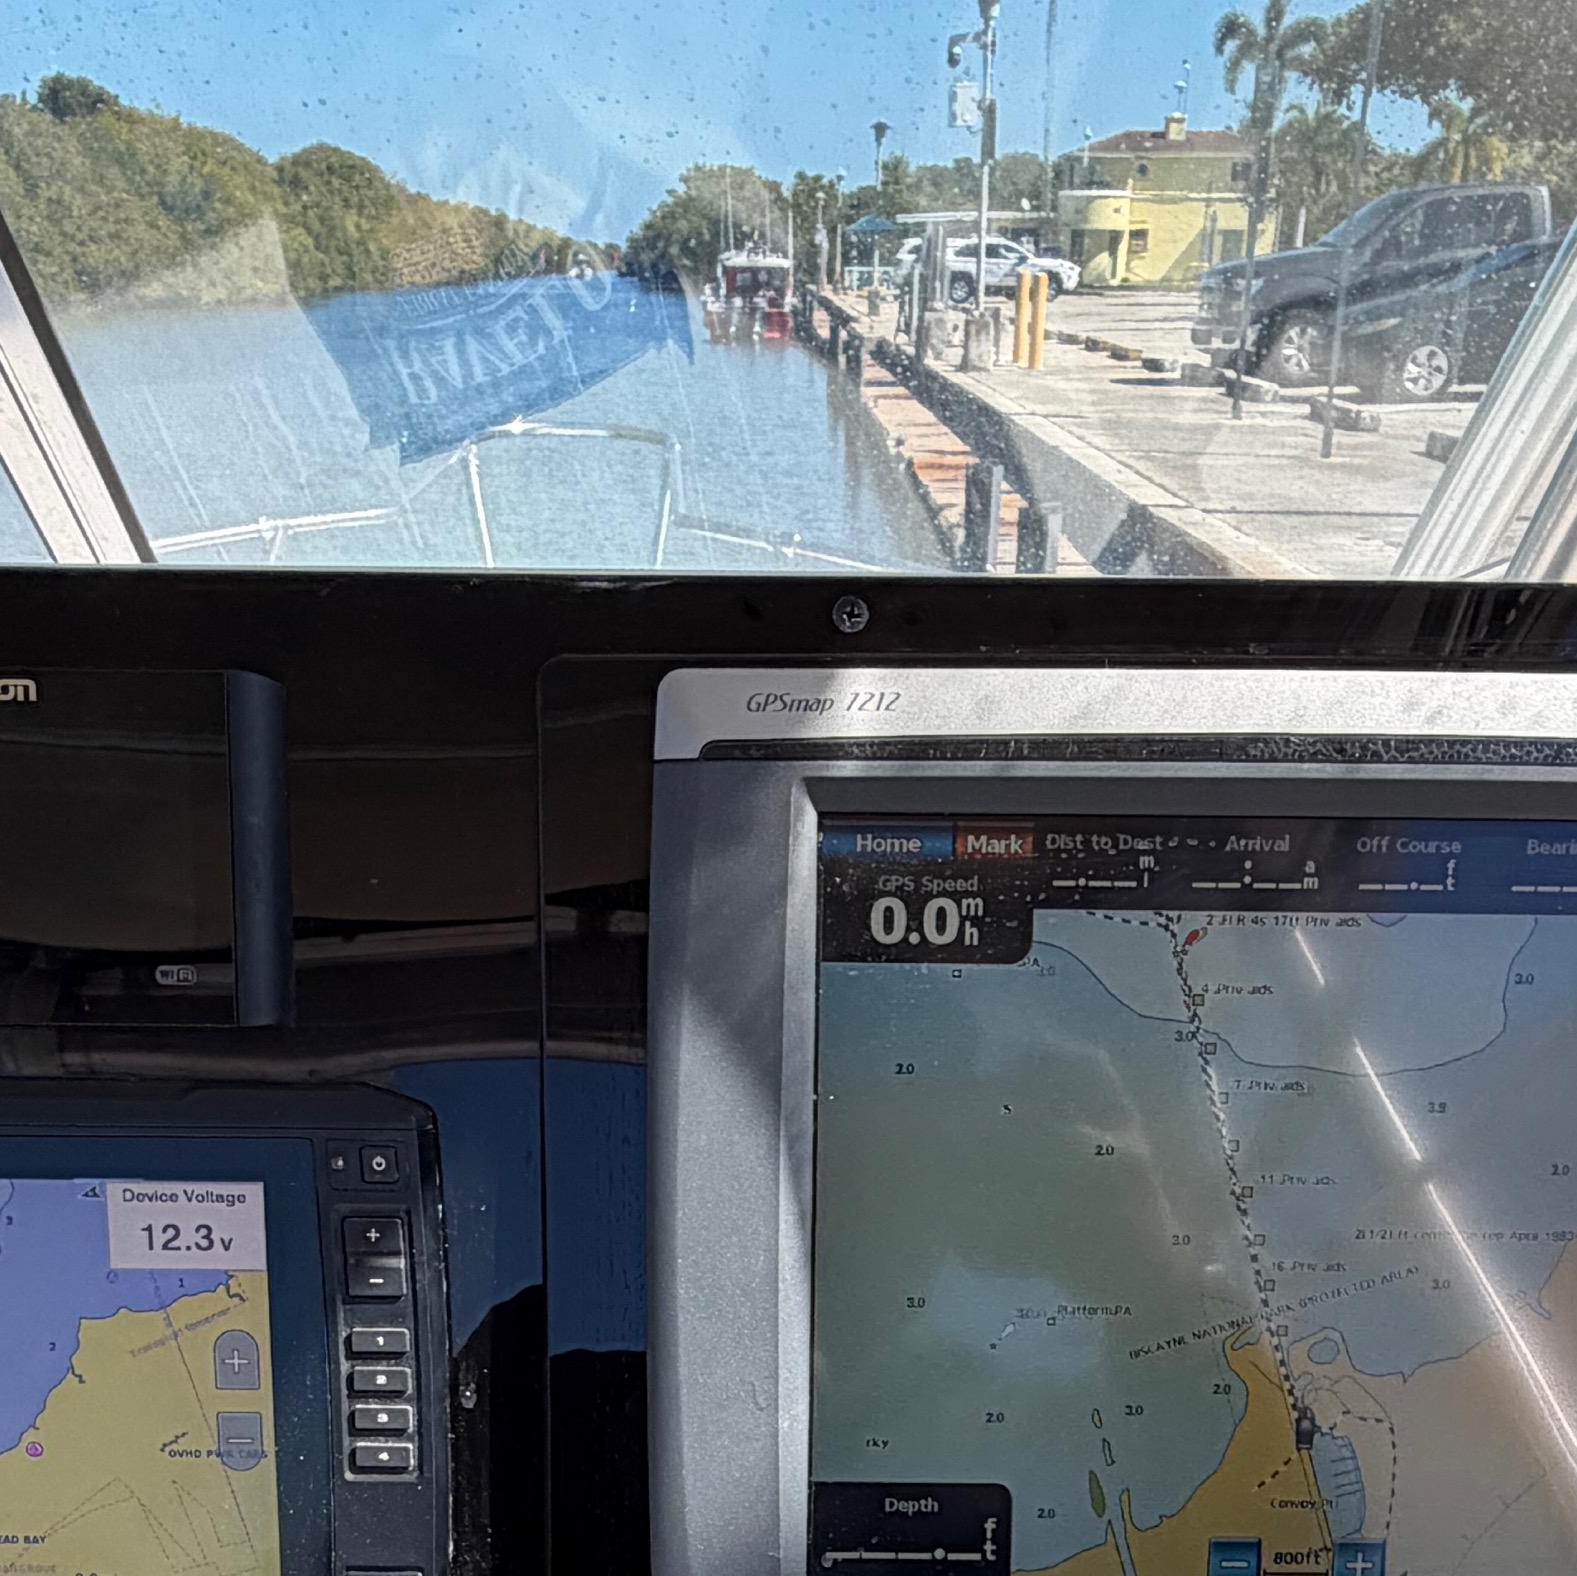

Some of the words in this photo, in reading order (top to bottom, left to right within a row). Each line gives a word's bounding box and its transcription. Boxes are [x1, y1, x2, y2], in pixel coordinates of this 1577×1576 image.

[844, 691, 902, 712] 7212
[855, 833, 923, 853] Home
[966, 834, 1024, 854] Mark
[1045, 833, 1083, 851] Dist
[1091, 833, 1113, 851] to
[1115, 833, 1164, 851] Dest
[1225, 834, 1291, 852] Arrival
[1357, 836, 1389, 854] Off
[1396, 837, 1463, 854] Course
[878, 875, 916, 892] GPS
[922, 875, 979, 894] Speed
[122, 1188, 179, 1204] Device
[182, 1189, 247, 1208] Voltage
[884, 1497, 940, 1517] Depth
